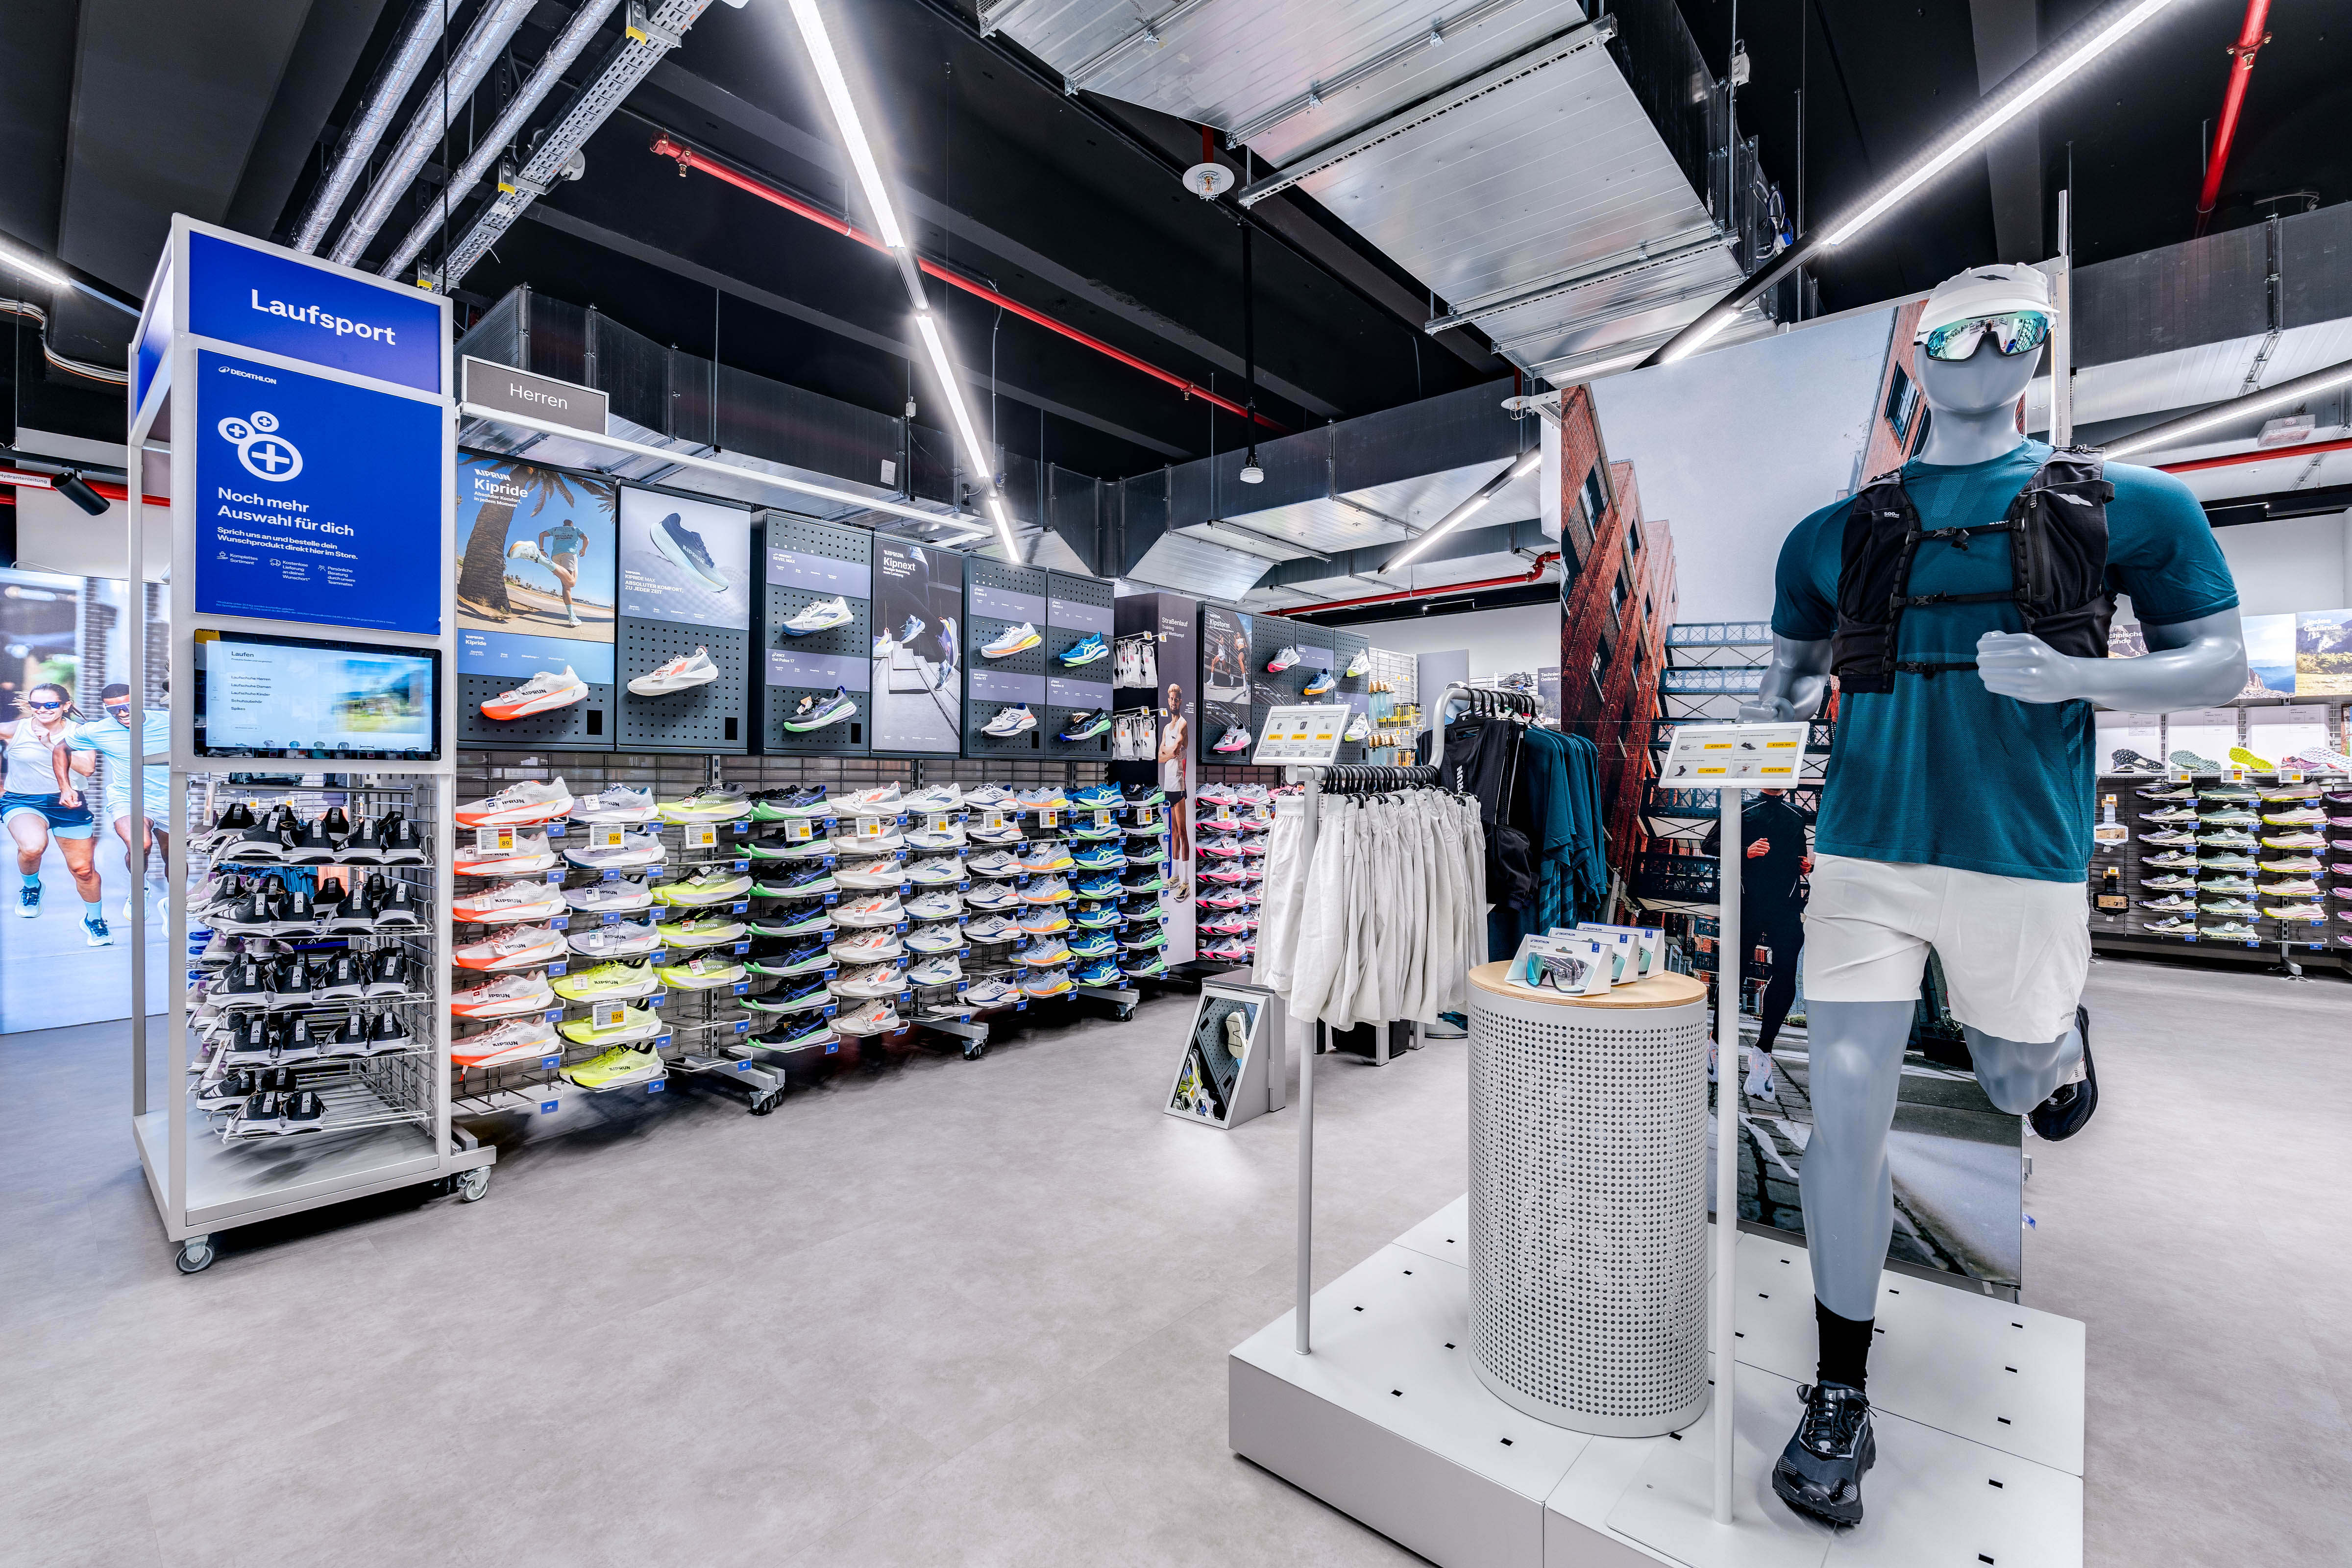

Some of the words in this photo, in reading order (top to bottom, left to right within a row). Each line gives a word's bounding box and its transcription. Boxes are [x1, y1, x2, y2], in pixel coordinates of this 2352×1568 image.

[251, 289, 396, 345] Laufsport
[230, 368, 277, 385] DECATHLON
[510, 383, 568, 410] Herren
[474, 468, 511, 481] KIPRUN
[474, 478, 528, 498] Kipride
[218, 487, 264, 506] Noch
[267, 498, 309, 513] mehr
[474, 491, 499, 499] Absoluter
[500, 495, 522, 504] Komfort,
[218, 505, 292, 527] Auswahl
[294, 517, 318, 530] für
[320, 522, 354, 536] dich
[218, 526, 245, 537] Sprich
[289, 537, 320, 547] bestelle
[218, 534, 284, 549] Wunschprodukt
[285, 544, 309, 553] direkt
[335, 551, 358, 560] Store.
[683, 544, 705, 564] KIPRUN
[883, 549, 904, 559] KIPRUN
[230, 553, 258, 561] Komplettes
[883, 557, 916, 571] Kipnext
[625, 580, 656, 588] ABSOLUTER
[657, 585, 684, 593] KOMFORT,
[1162, 617, 1188, 627] Straßenlauf
[1209, 618, 1230, 628] Kipstorm
